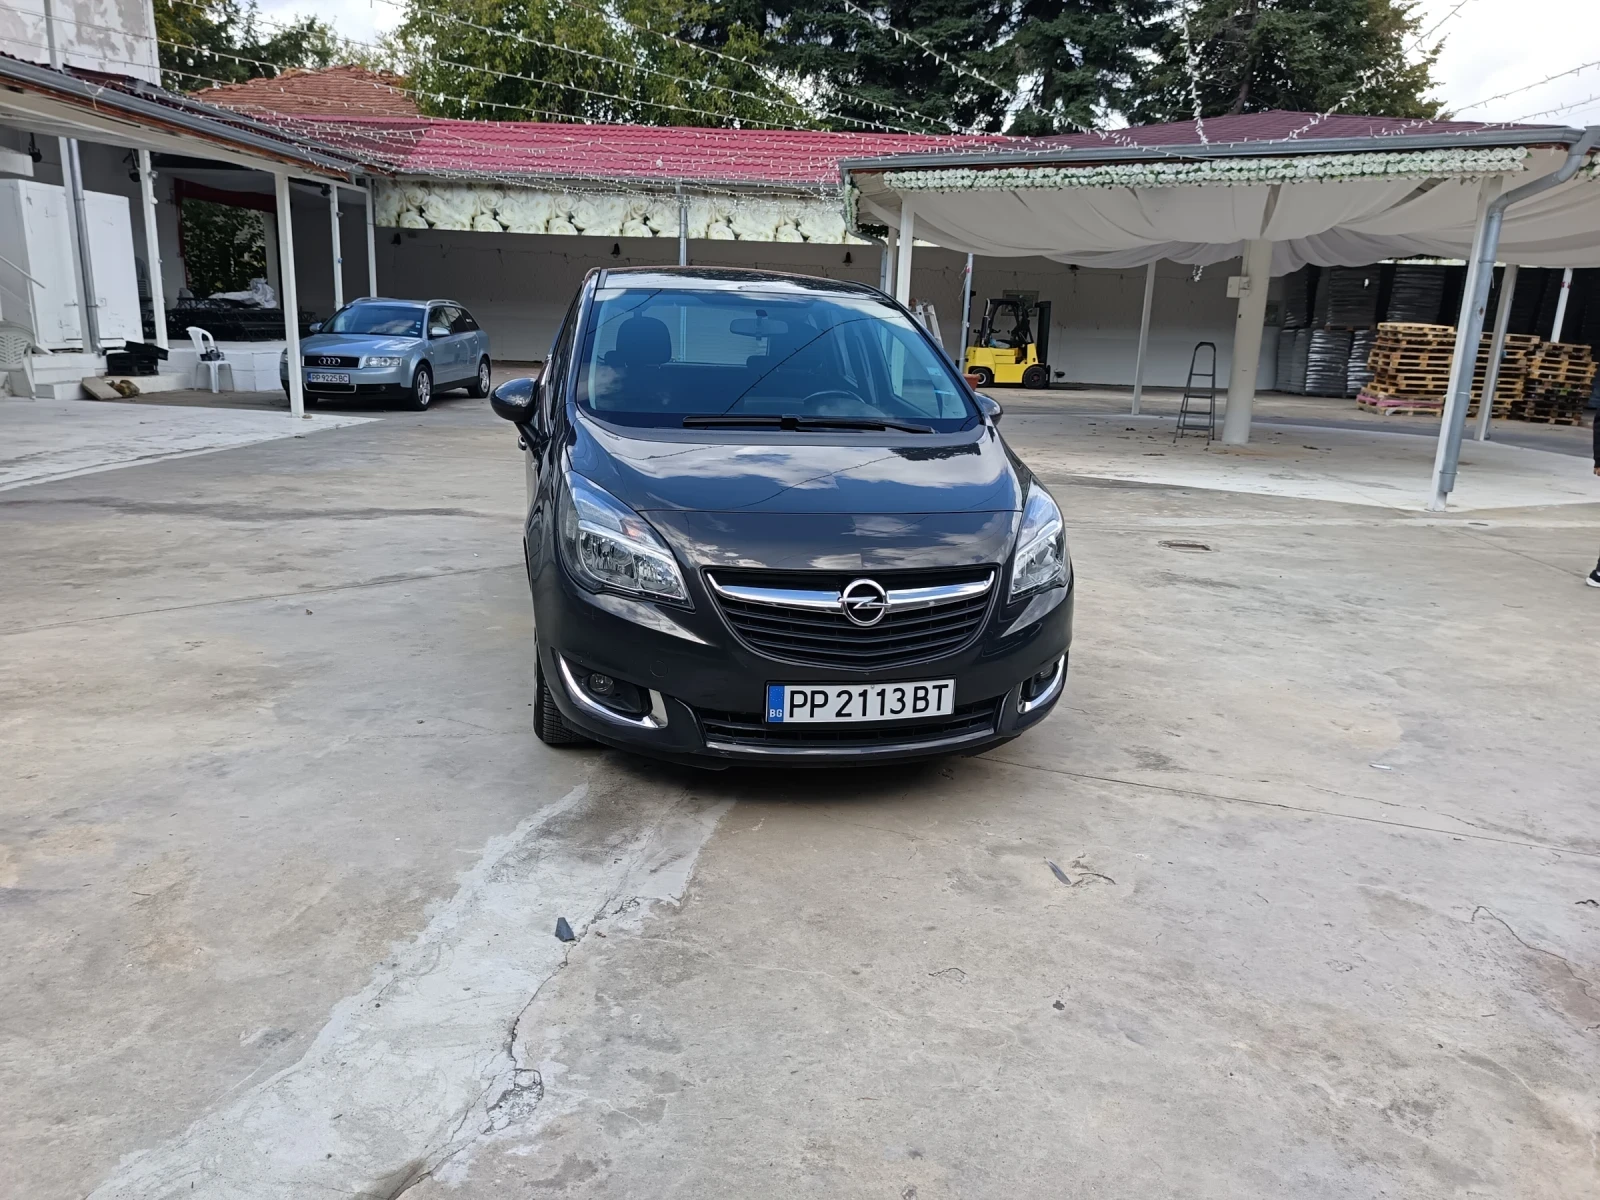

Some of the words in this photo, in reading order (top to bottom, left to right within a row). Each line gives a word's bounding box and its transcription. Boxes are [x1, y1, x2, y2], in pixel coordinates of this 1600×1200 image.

[322, 374, 338, 382] 9225
[789, 690, 829, 718] PP
[835, 687, 906, 718] 2113
[912, 684, 949, 713] BT
[769, 709, 783, 718] BG
